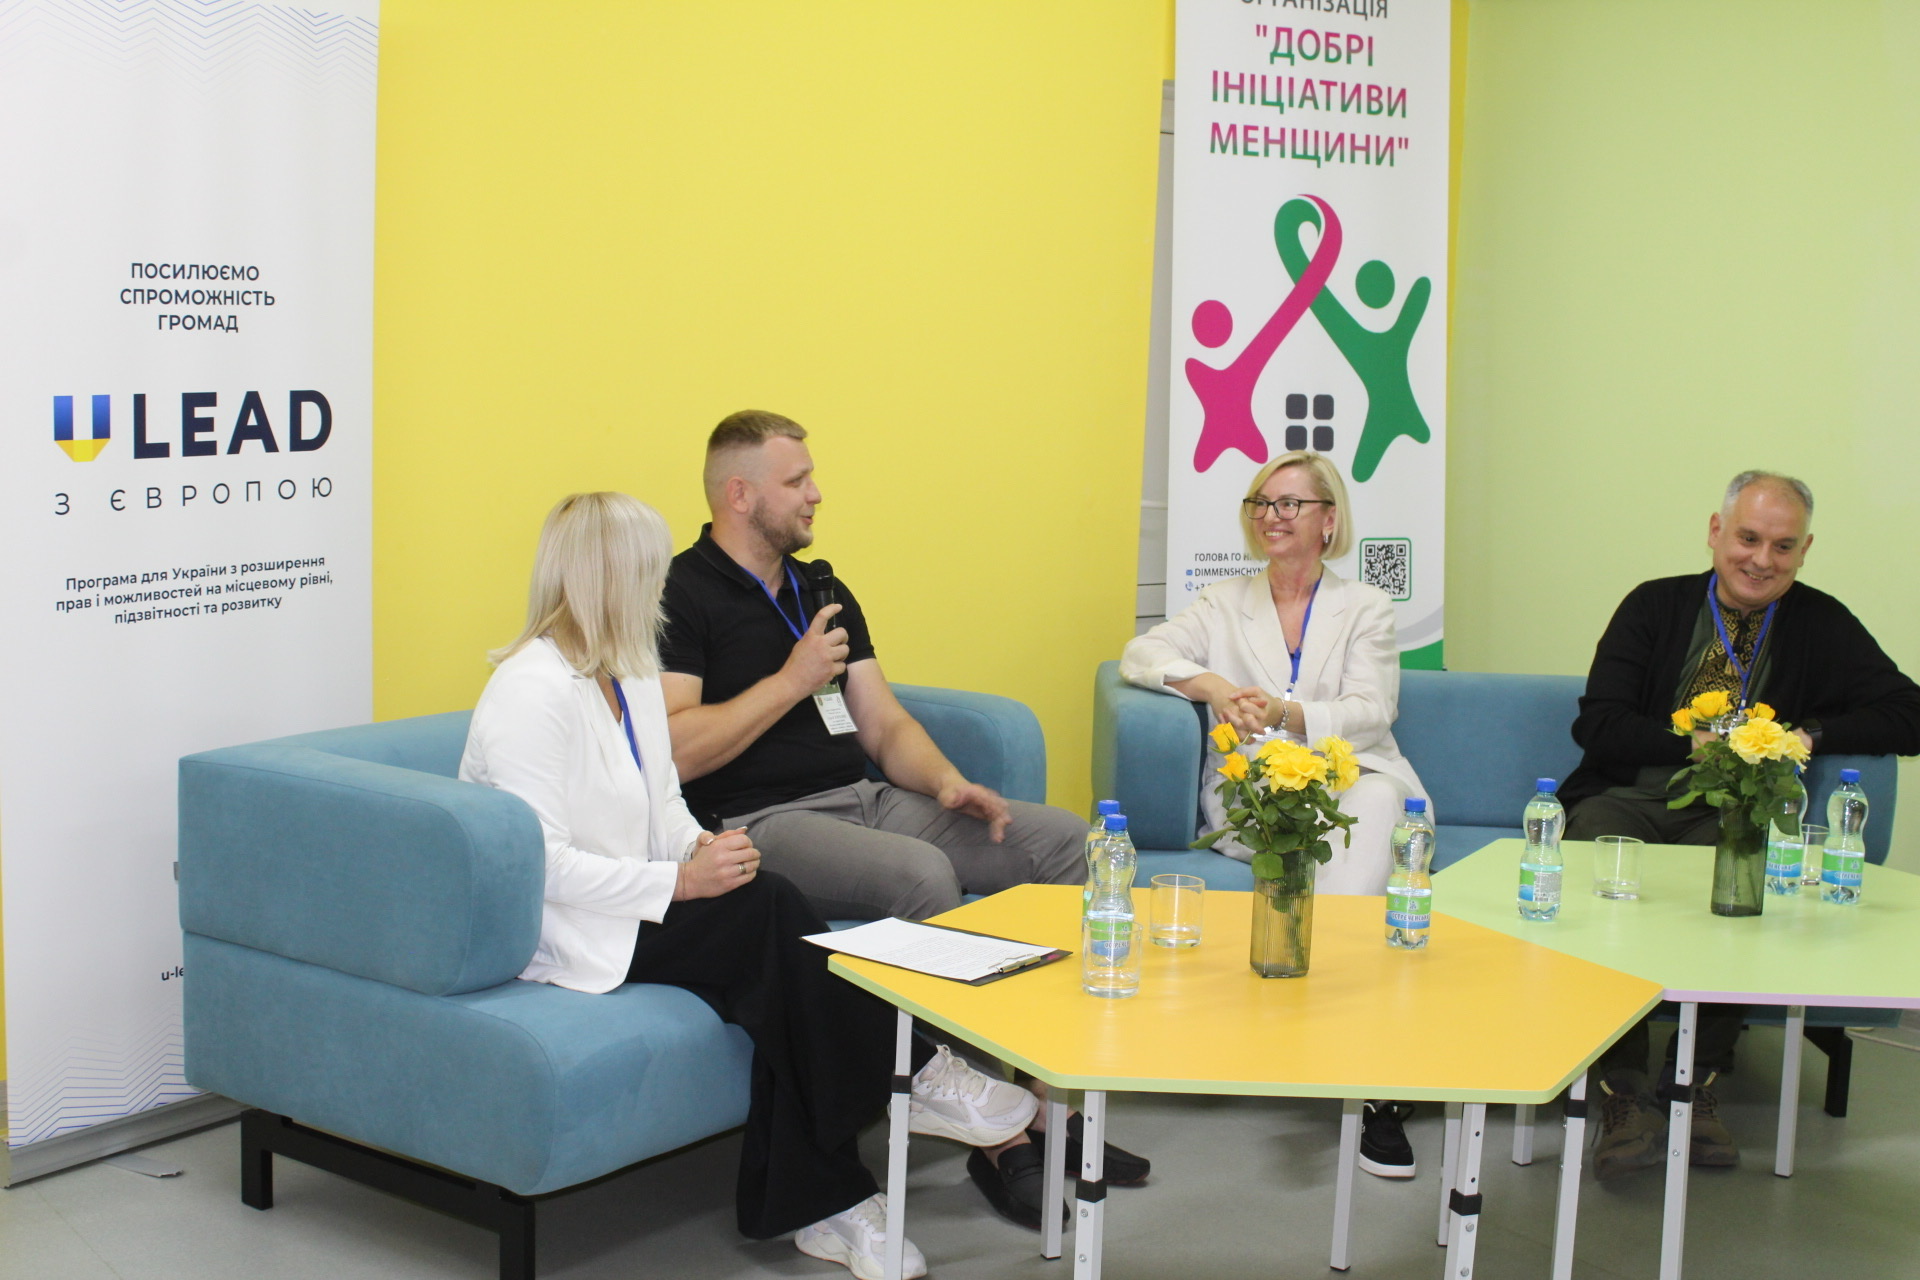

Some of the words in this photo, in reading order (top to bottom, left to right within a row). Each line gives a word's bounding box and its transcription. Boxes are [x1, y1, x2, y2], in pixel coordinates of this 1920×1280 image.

[1240, 0, 1388, 21] НІЗАЦІЯ
[1256, 24, 1374, 67] "ДОБРІ
[1212, 70, 1407, 119] ІНІЦІАТИВИ
[1210, 122, 1409, 168] МЕНЩИНИ"
[131, 263, 260, 281] ПОСИЛЮЄМО
[119, 288, 275, 306] СПРОМОЖНІСТЬ
[158, 314, 239, 333] ГРОМАД
[54, 492, 71, 516] З
[110, 477, 333, 512] ЄВРОПОЮ
[1195, 553, 1229, 562] ГОЛОВА
[1231, 553, 1241, 561] ГО
[66, 574, 138, 592] Програма
[141, 569, 169, 584] для
[172, 564, 227, 580] України
[230, 564, 238, 575] з
[241, 557, 326, 577] розширення
[56, 597, 92, 613] прав
[96, 594, 100, 607] і
[104, 583, 202, 607] можливостей
[206, 584, 222, 596] на
[225, 574, 296, 593] місцевому
[300, 571, 333, 589] рівні,
[115, 603, 200, 624] підзвітності
[204, 602, 219, 615] та
[221, 595, 283, 615] розвитку
